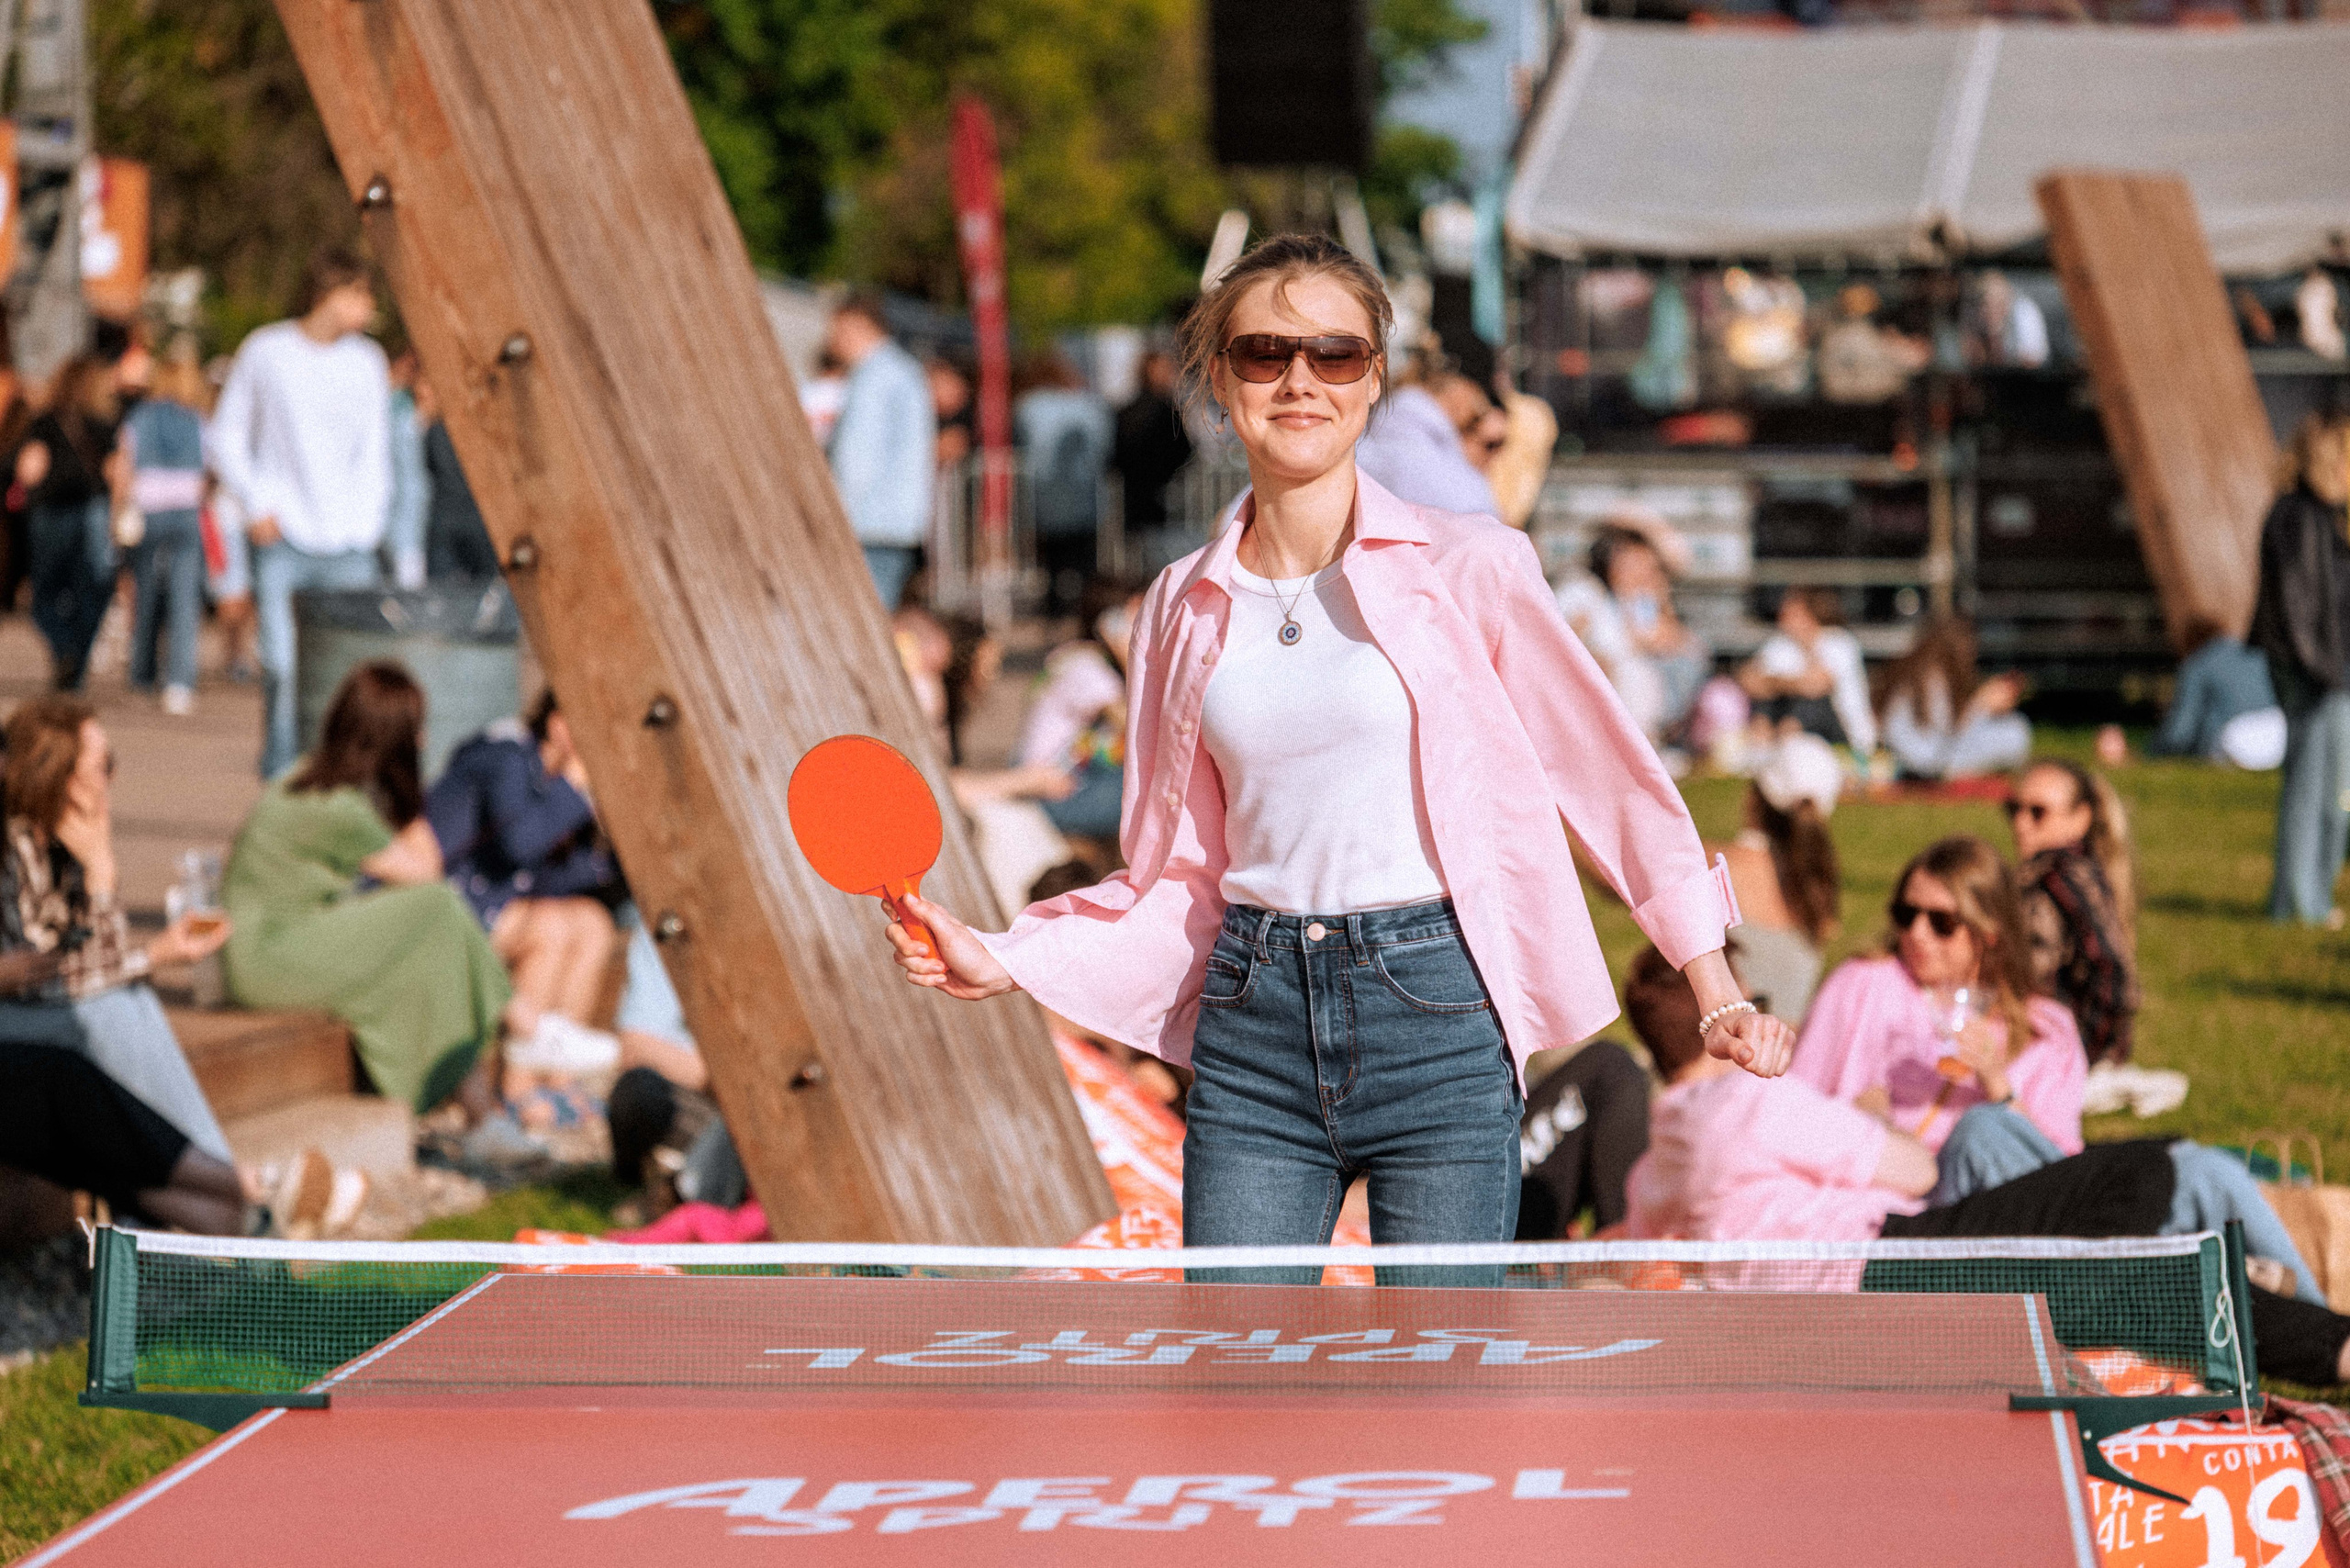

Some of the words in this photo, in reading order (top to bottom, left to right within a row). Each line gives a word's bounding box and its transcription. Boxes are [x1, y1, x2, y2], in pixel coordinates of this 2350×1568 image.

[763, 1339, 1664, 1369] APEROL
[562, 1469, 1630, 1519] APEROL
[726, 1496, 1446, 1536] SPRITZ
